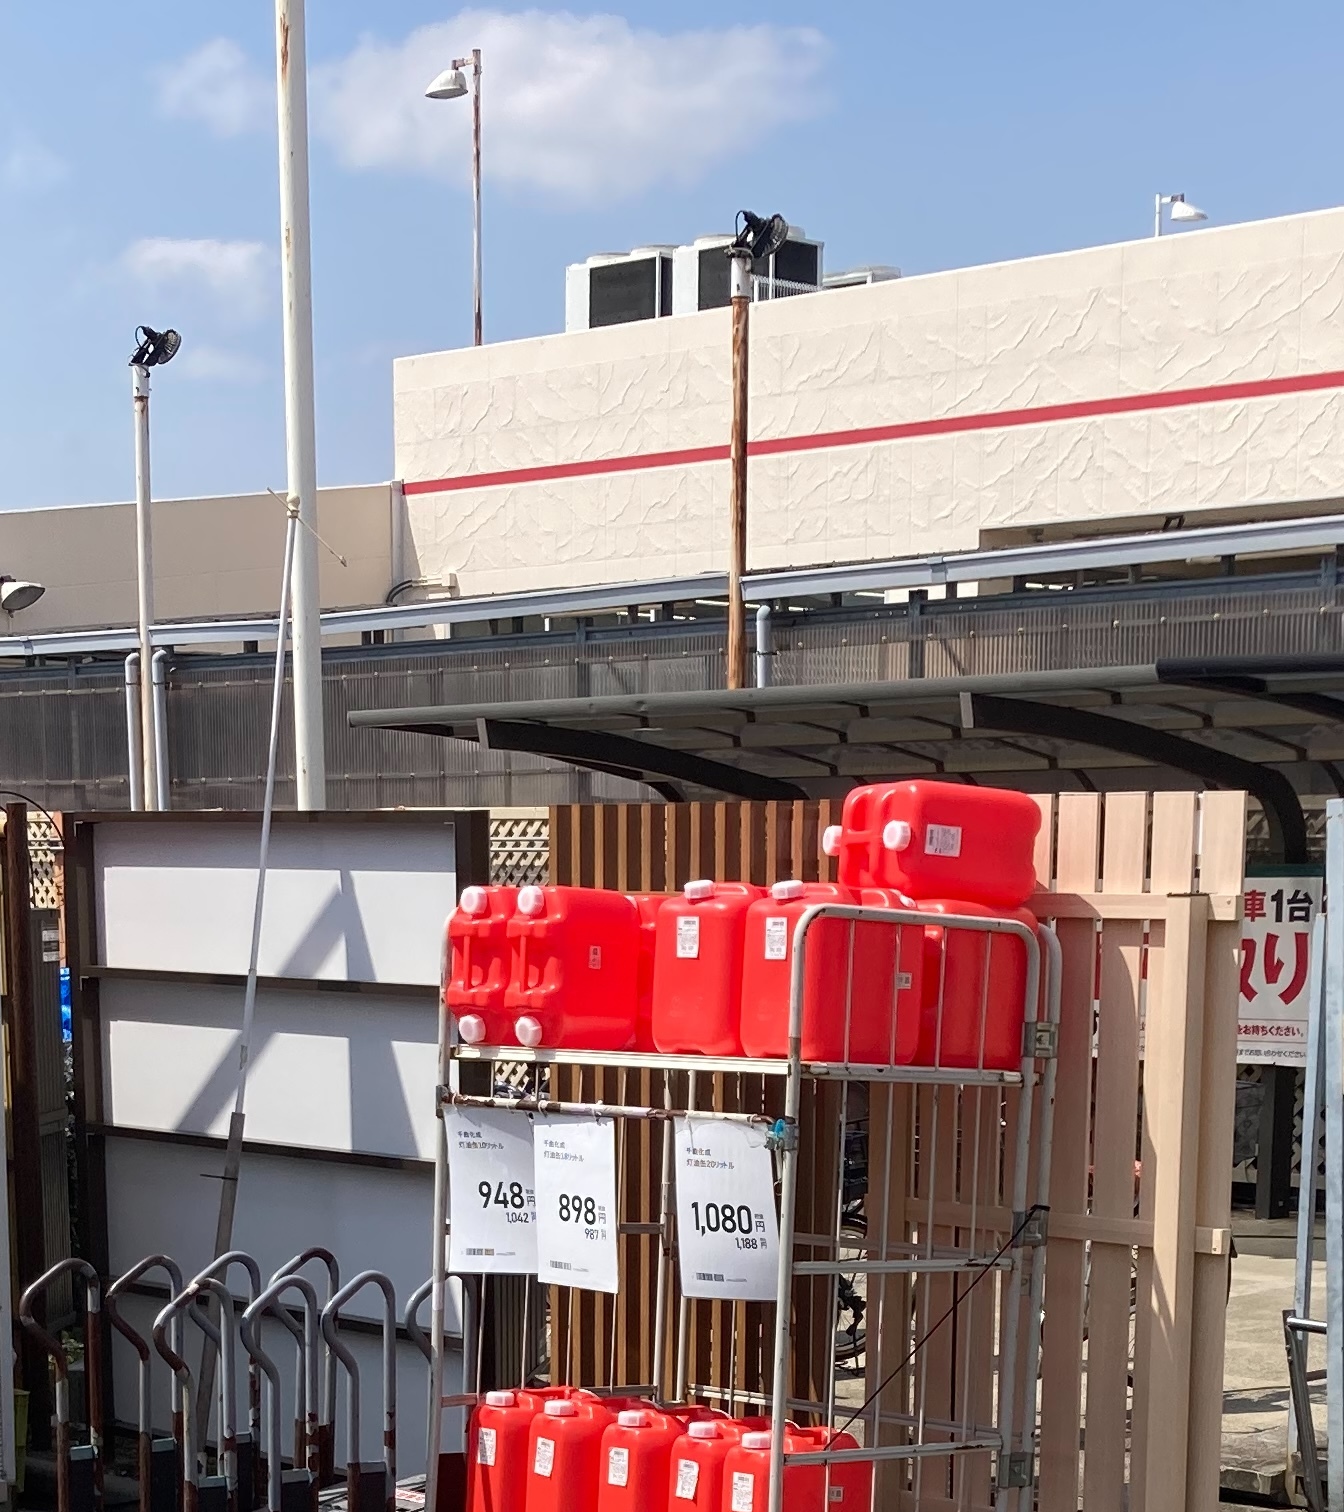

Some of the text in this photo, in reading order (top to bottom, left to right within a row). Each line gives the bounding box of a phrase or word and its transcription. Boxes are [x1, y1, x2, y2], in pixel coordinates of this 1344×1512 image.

[478, 1181, 525, 1209] 948
[558, 1193, 597, 1226] 898
[691, 1202, 753, 1236] 1,080
[584, 1227, 599, 1241] 987
[735, 1237, 757, 1251] 1,188
